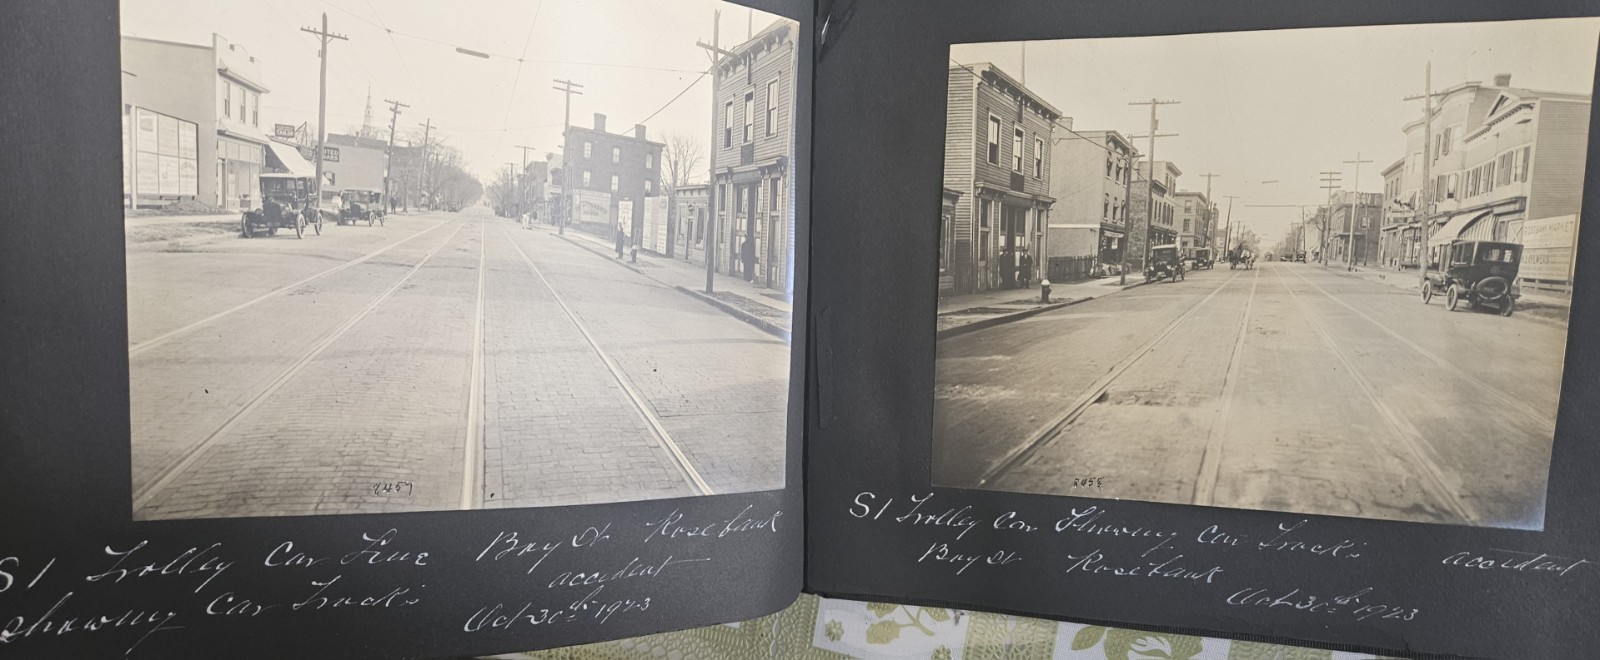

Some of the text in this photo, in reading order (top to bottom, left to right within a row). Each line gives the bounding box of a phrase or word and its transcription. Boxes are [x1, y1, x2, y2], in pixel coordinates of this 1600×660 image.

[993, 511, 1038, 532] Car
[1197, 524, 1239, 546] Car
[264, 541, 316, 568] Car
[340, 528, 429, 565] Line
[476, 531, 564, 575] Bay
[918, 542, 982, 575] Bay
[206, 591, 265, 617] Car
[595, 597, 651, 625] 1923
[1353, 604, 1419, 621] 1923
